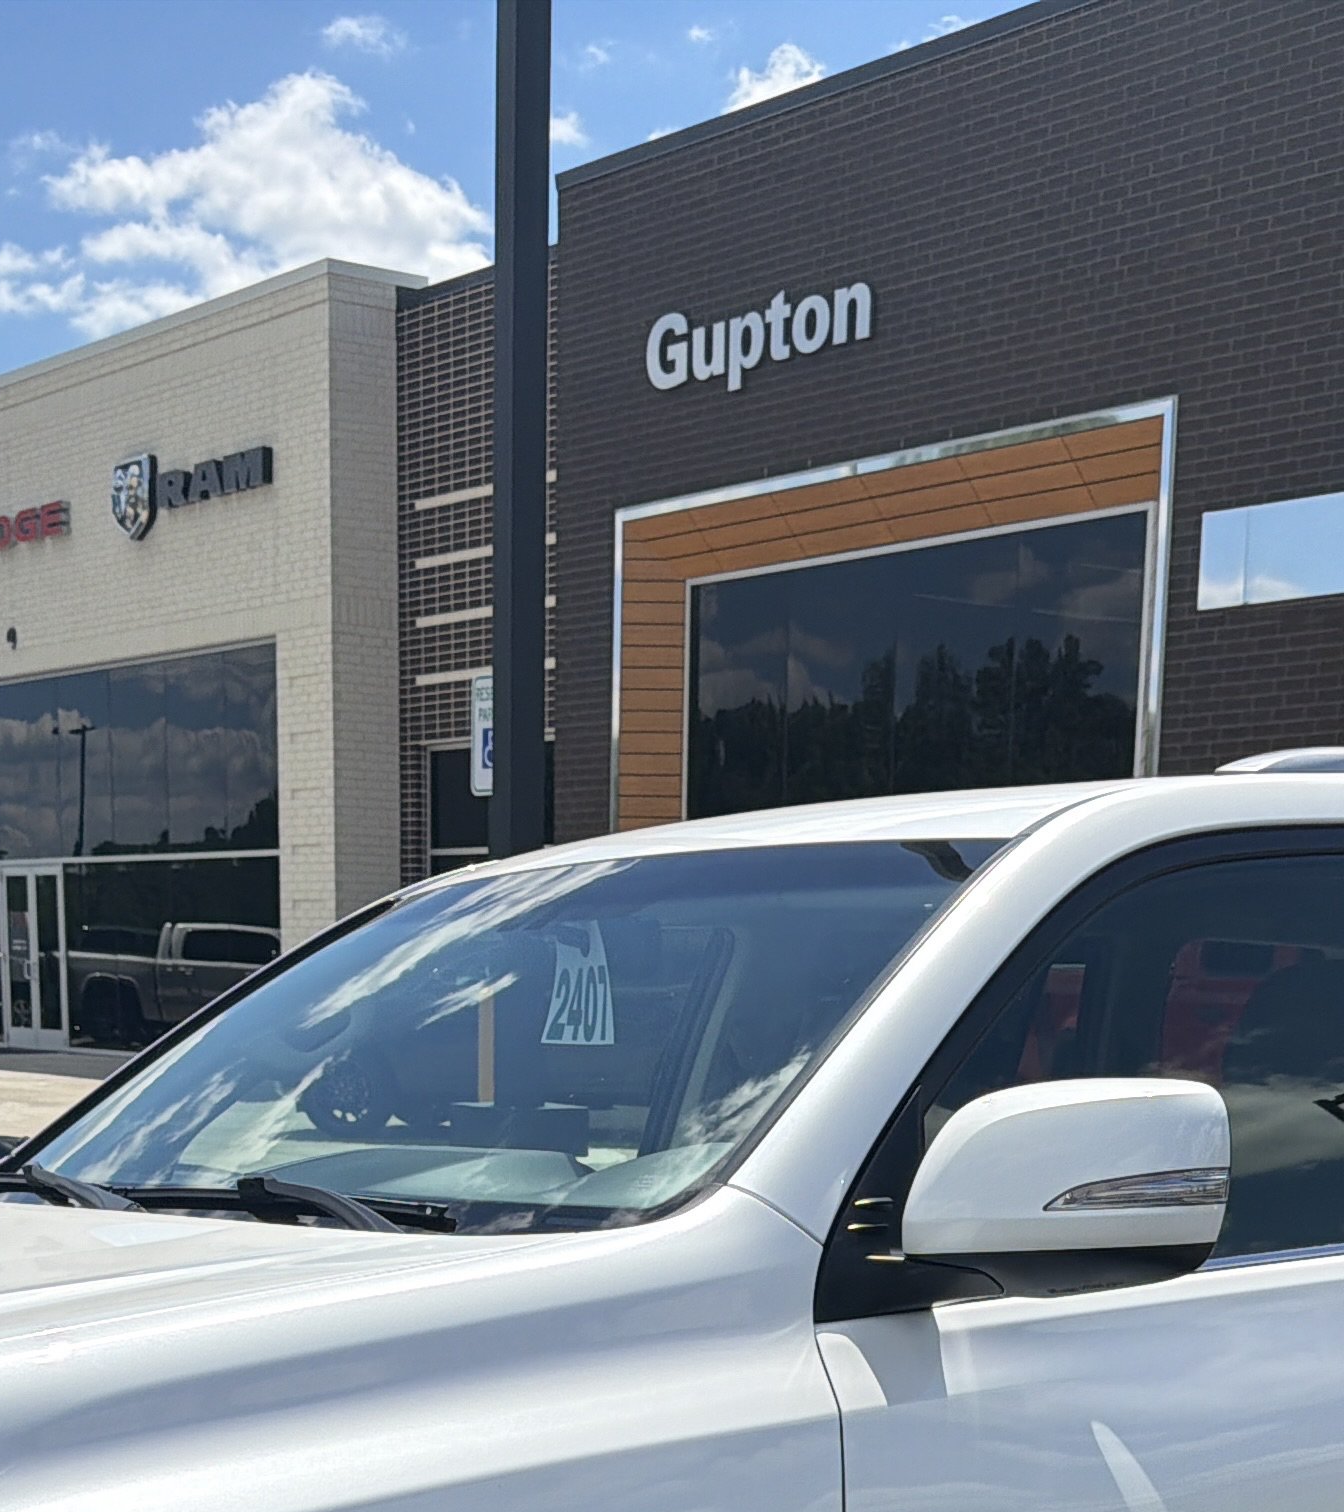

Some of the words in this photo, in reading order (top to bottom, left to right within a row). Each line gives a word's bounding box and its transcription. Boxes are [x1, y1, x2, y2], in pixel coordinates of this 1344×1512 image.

[646, 281, 873, 391] Gupton
[158, 445, 273, 509] RAM
[545, 965, 608, 1042] 2407
